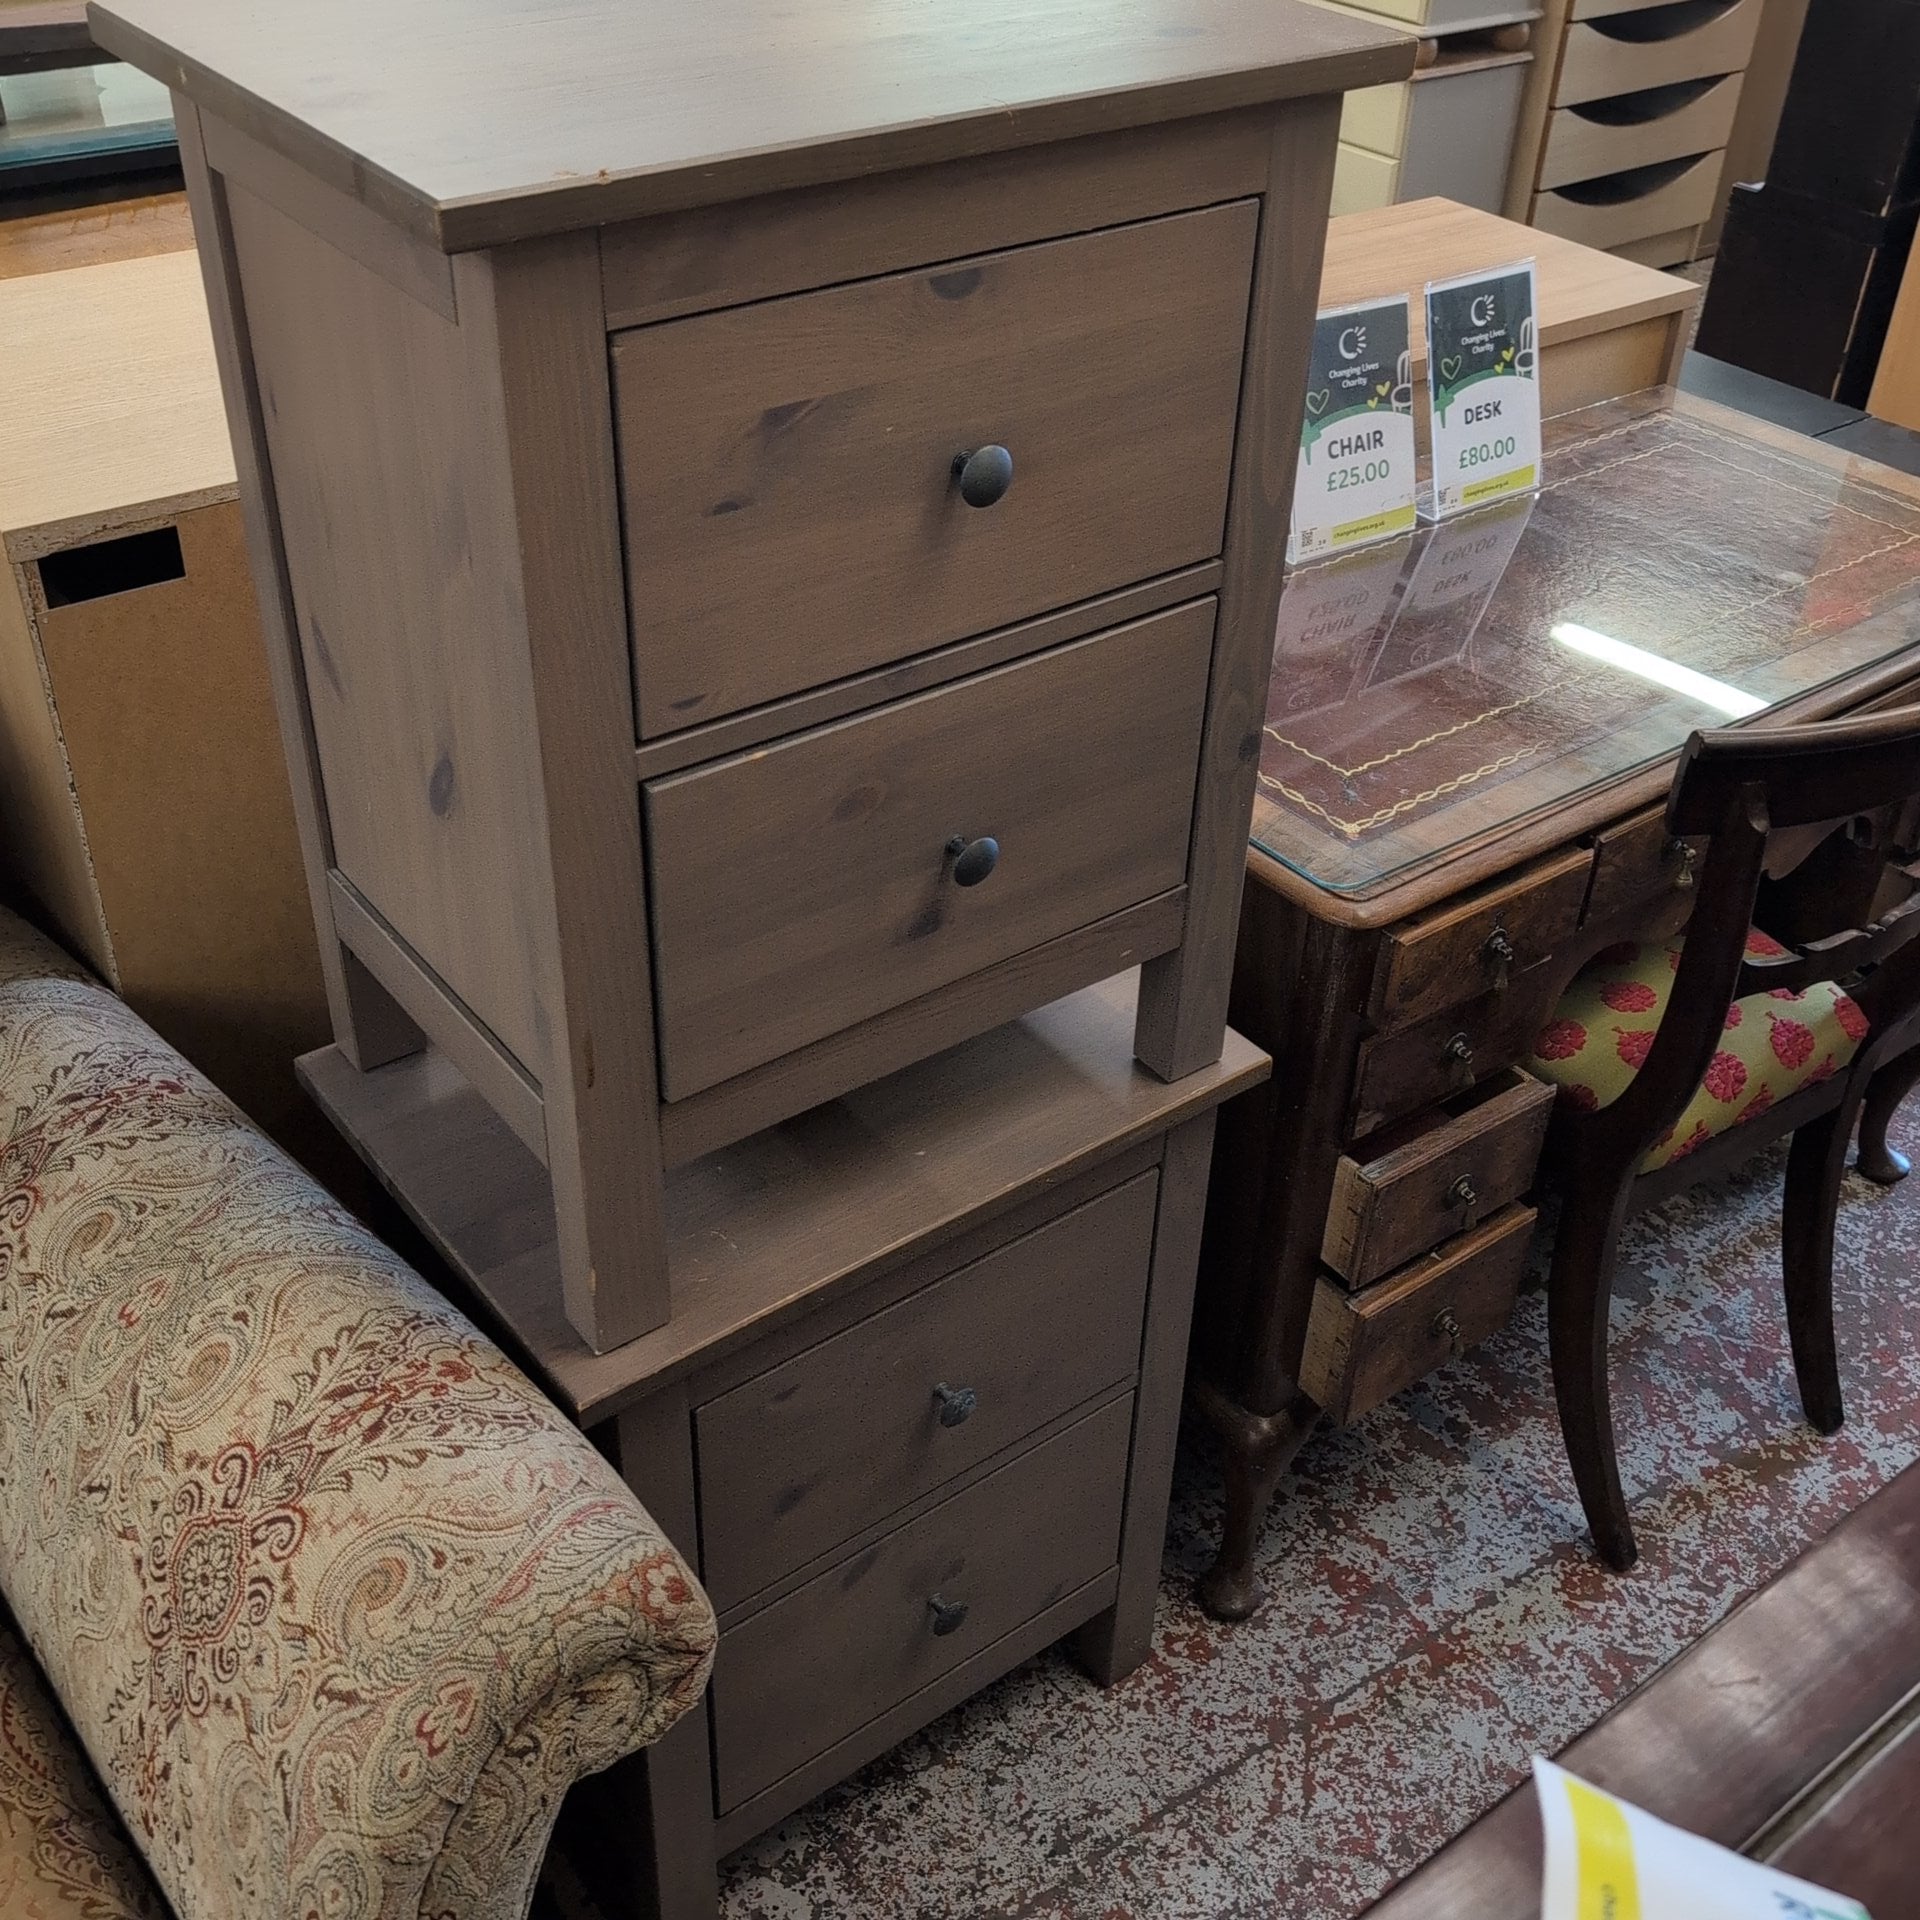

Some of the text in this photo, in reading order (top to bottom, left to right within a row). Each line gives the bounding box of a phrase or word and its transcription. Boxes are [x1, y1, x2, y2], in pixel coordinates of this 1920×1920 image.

[1461, 329, 1506, 346] Changing Lives
[1472, 343, 1494, 355] Charity
[1328, 362, 1380, 379] Changing Lives
[1341, 376, 1368, 389] Charity
[1464, 400, 1503, 425] DESK
[1327, 430, 1385, 460] CHAIR
[1459, 436, 1516, 469] £80.00
[1327, 459, 1390, 492] £25.00
